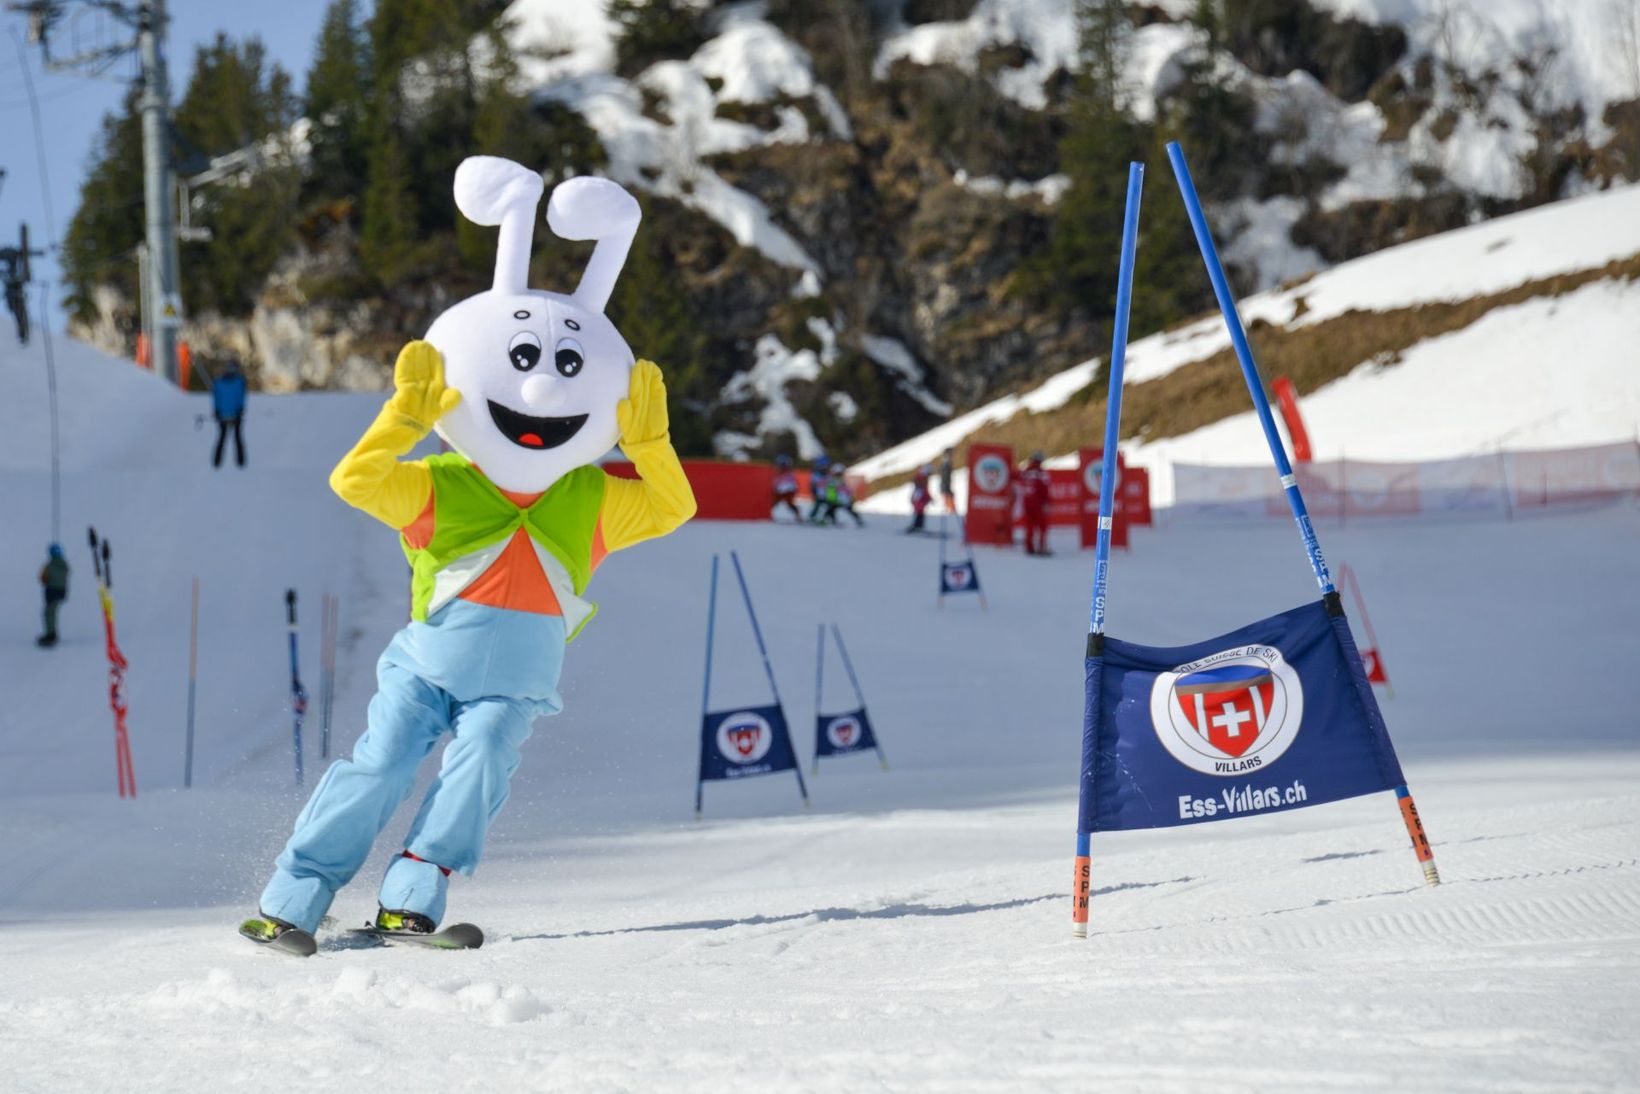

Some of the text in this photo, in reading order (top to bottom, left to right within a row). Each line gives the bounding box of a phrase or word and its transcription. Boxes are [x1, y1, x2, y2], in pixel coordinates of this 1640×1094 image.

[1246, 646, 1262, 656] DE
[1263, 648, 1279, 663] SKI
[1215, 755, 1263, 773] VILLARS
[1178, 780, 1308, 820] Ess-Villars.ch
[1079, 864, 1090, 909] SPM
